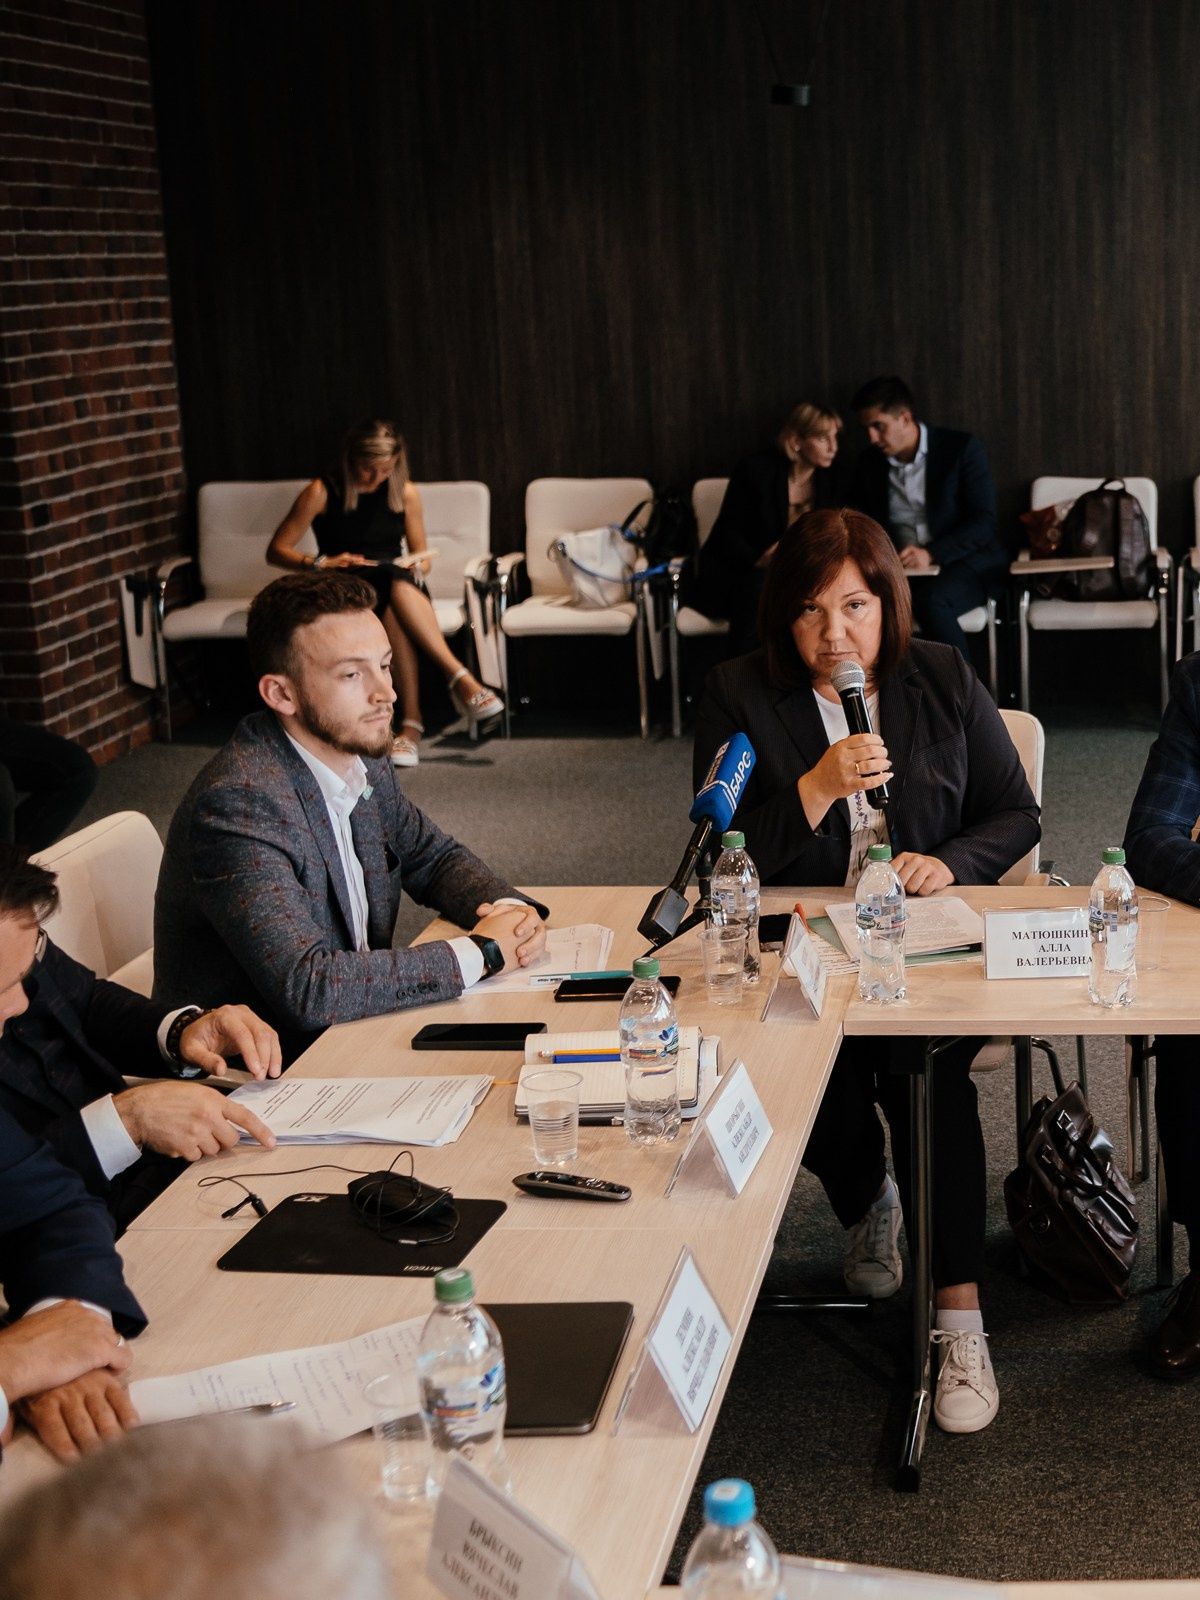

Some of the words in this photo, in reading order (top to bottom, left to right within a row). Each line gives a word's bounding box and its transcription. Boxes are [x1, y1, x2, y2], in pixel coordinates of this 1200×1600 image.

[730, 751, 751, 798] БАРС
[1012, 930, 1089, 940] МАТЮШКИН
[1038, 943, 1071, 952] АЛЛА
